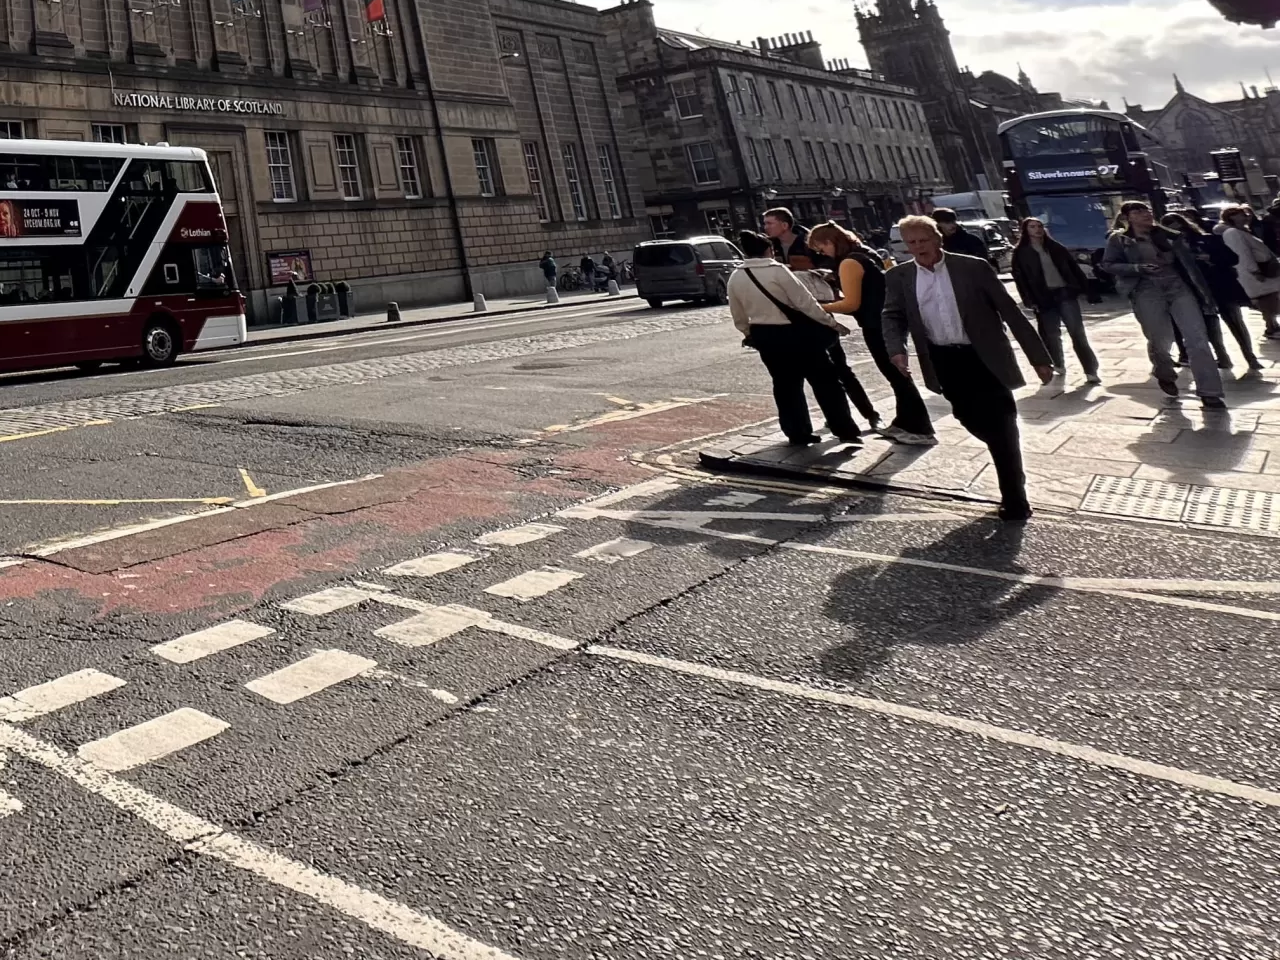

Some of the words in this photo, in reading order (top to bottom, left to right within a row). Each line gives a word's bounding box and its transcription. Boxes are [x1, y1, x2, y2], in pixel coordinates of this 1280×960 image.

[114, 93, 173, 109] NATIONAL
[175, 96, 215, 111] LIBRARY
[217, 99, 232, 112] OF
[233, 100, 282, 114] SCOTLAND
[1028, 169, 1097, 179] Silverknowes
[1098, 165, 1119, 175] 27
[23, 208, 30, 217] 24
[31, 208, 40, 217] OCT
[23, 218, 61, 228] LYCEUM.ORG.UK
[188, 228, 211, 237] Lothian
